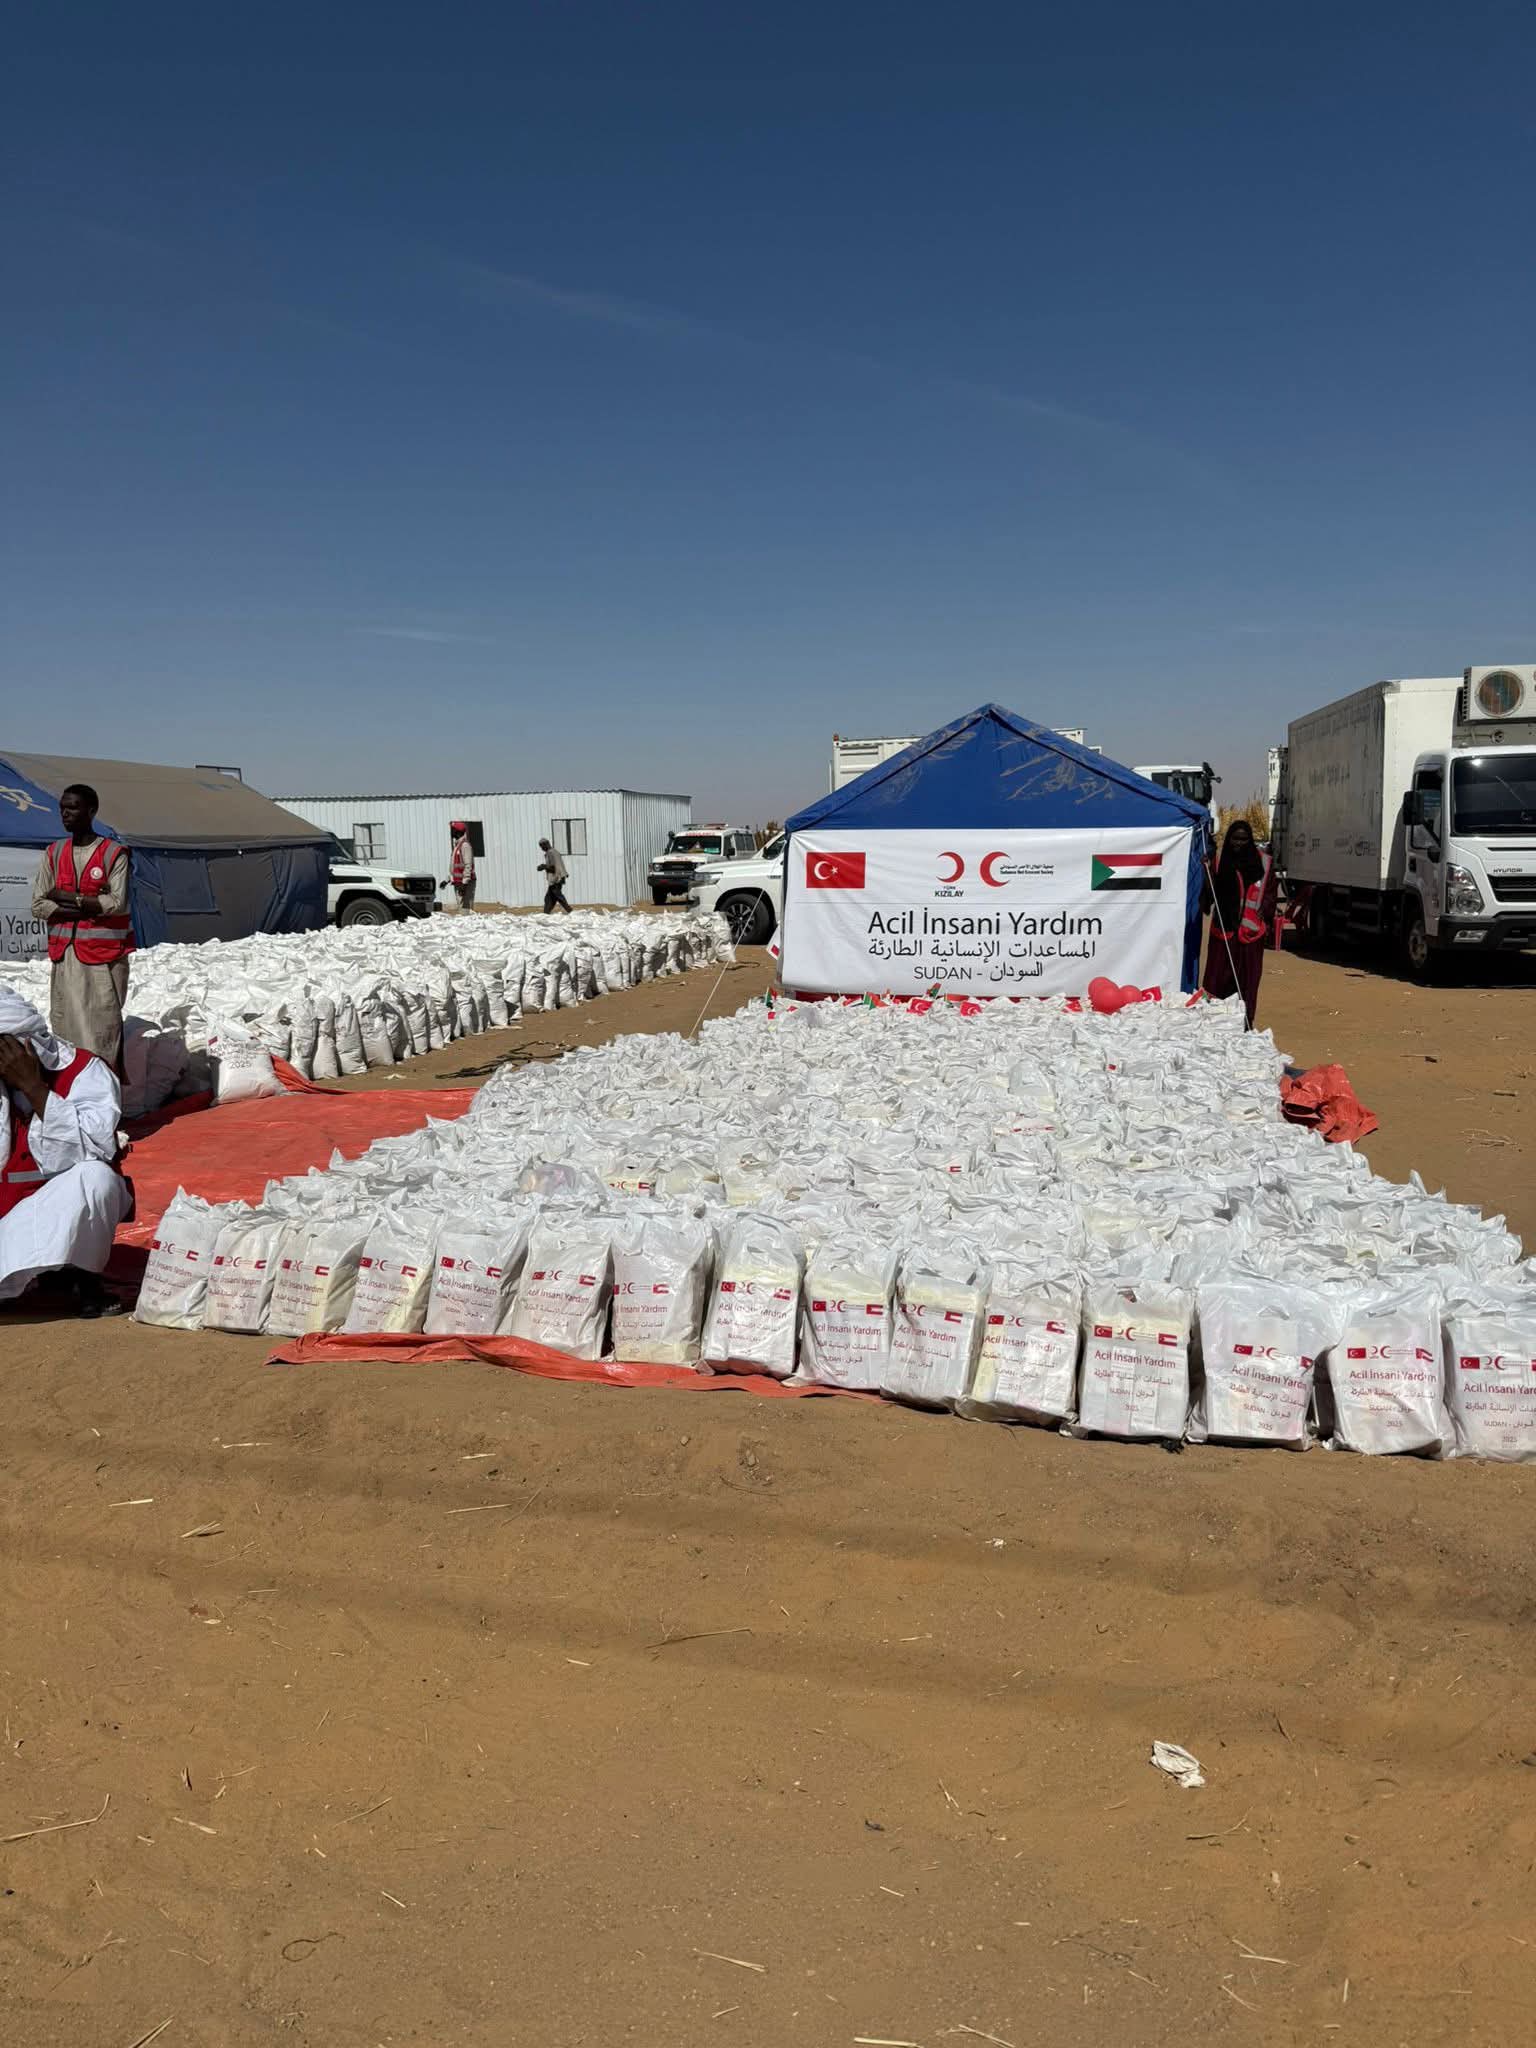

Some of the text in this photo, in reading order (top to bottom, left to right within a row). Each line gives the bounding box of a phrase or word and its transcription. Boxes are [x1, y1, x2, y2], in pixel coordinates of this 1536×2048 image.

[6, 915, 46, 935] Yardı
[868, 907, 1102, 935] Acil İnsani Yardım
[868, 938, 1095, 963] المساعدات الإنسانية الطارئة
[914, 966, 972, 980] SUDAN
[990, 961, 1042, 982] السودان
[1094, 1350, 1112, 1361] Acil
[1143, 1354, 1176, 1369] Yardım
[1232, 1364, 1250, 1377] Acil
[1349, 1370, 1368, 1379] Acil
[1463, 1382, 1482, 1393] Acil
